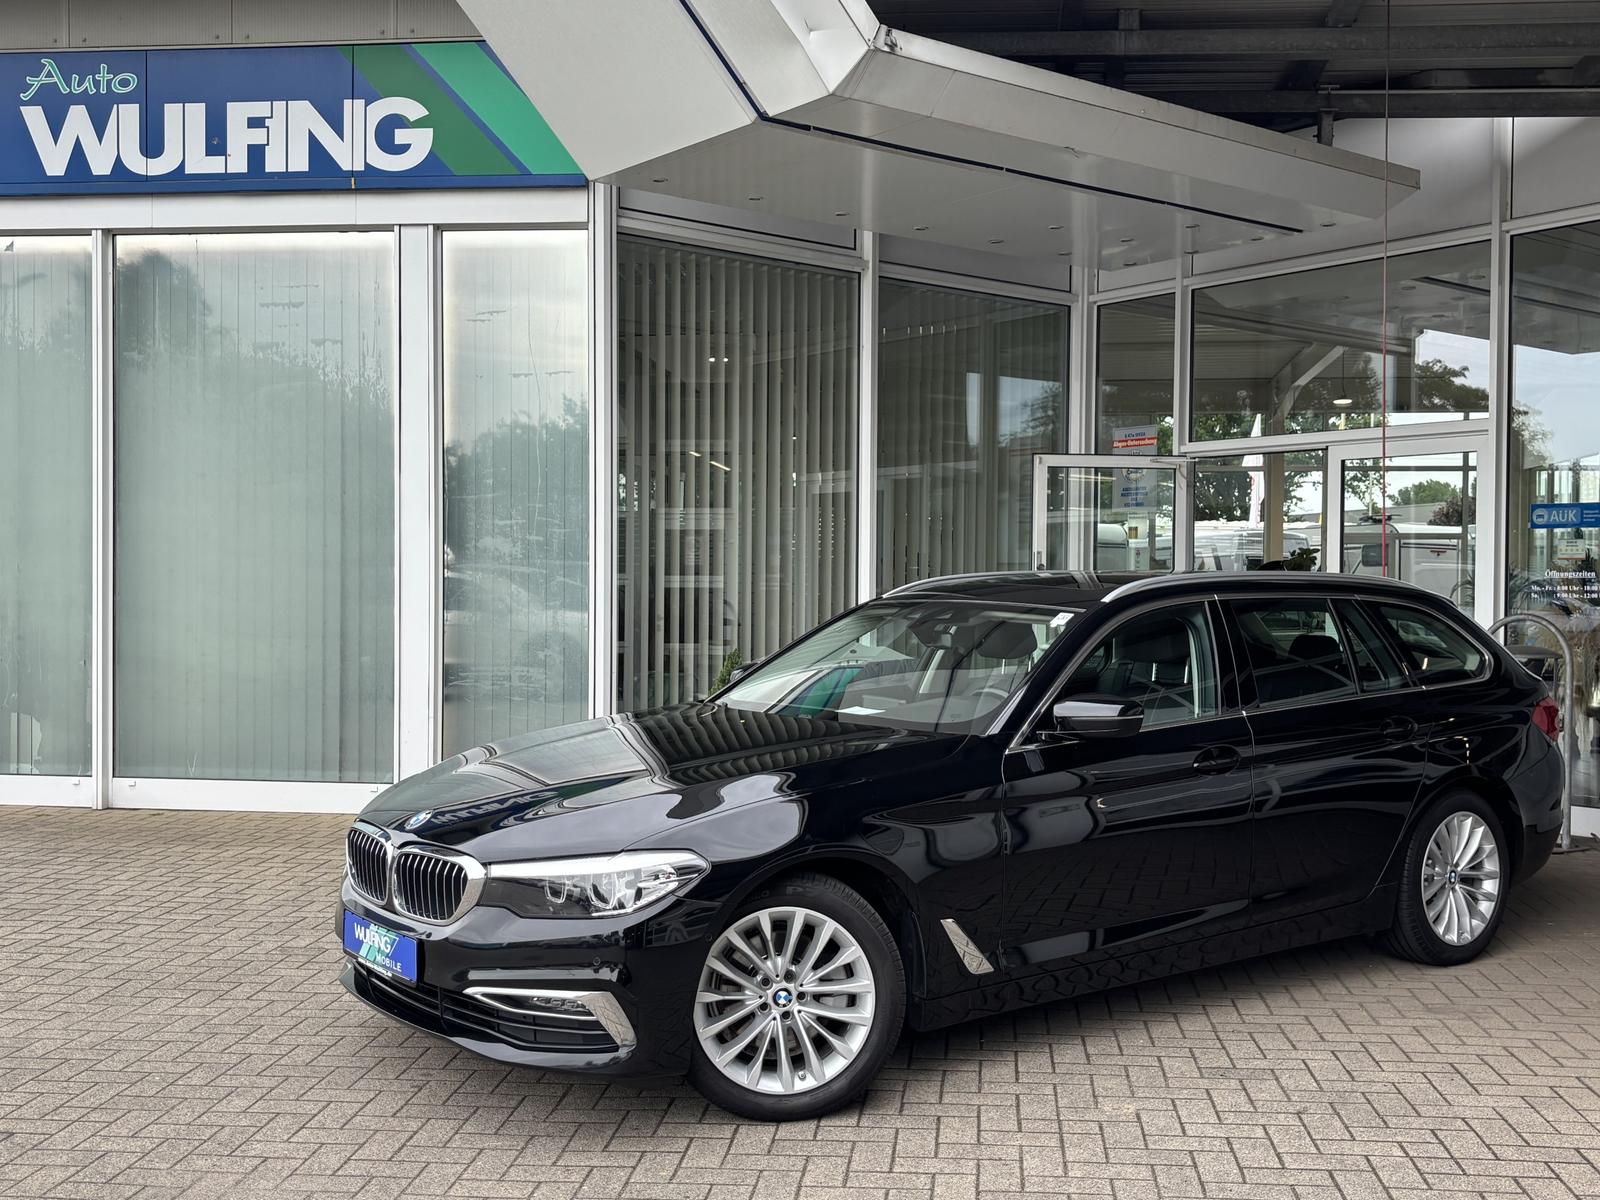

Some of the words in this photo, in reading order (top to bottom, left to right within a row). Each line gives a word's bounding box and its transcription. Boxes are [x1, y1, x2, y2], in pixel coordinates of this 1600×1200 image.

[20, 58, 138, 101] Auto
[19, 97, 434, 176] WULFING
[1544, 569, 1596, 579] Öffnungszeiten
[354, 921, 391, 953] WULFING
[375, 950, 402, 972] MOBILE
